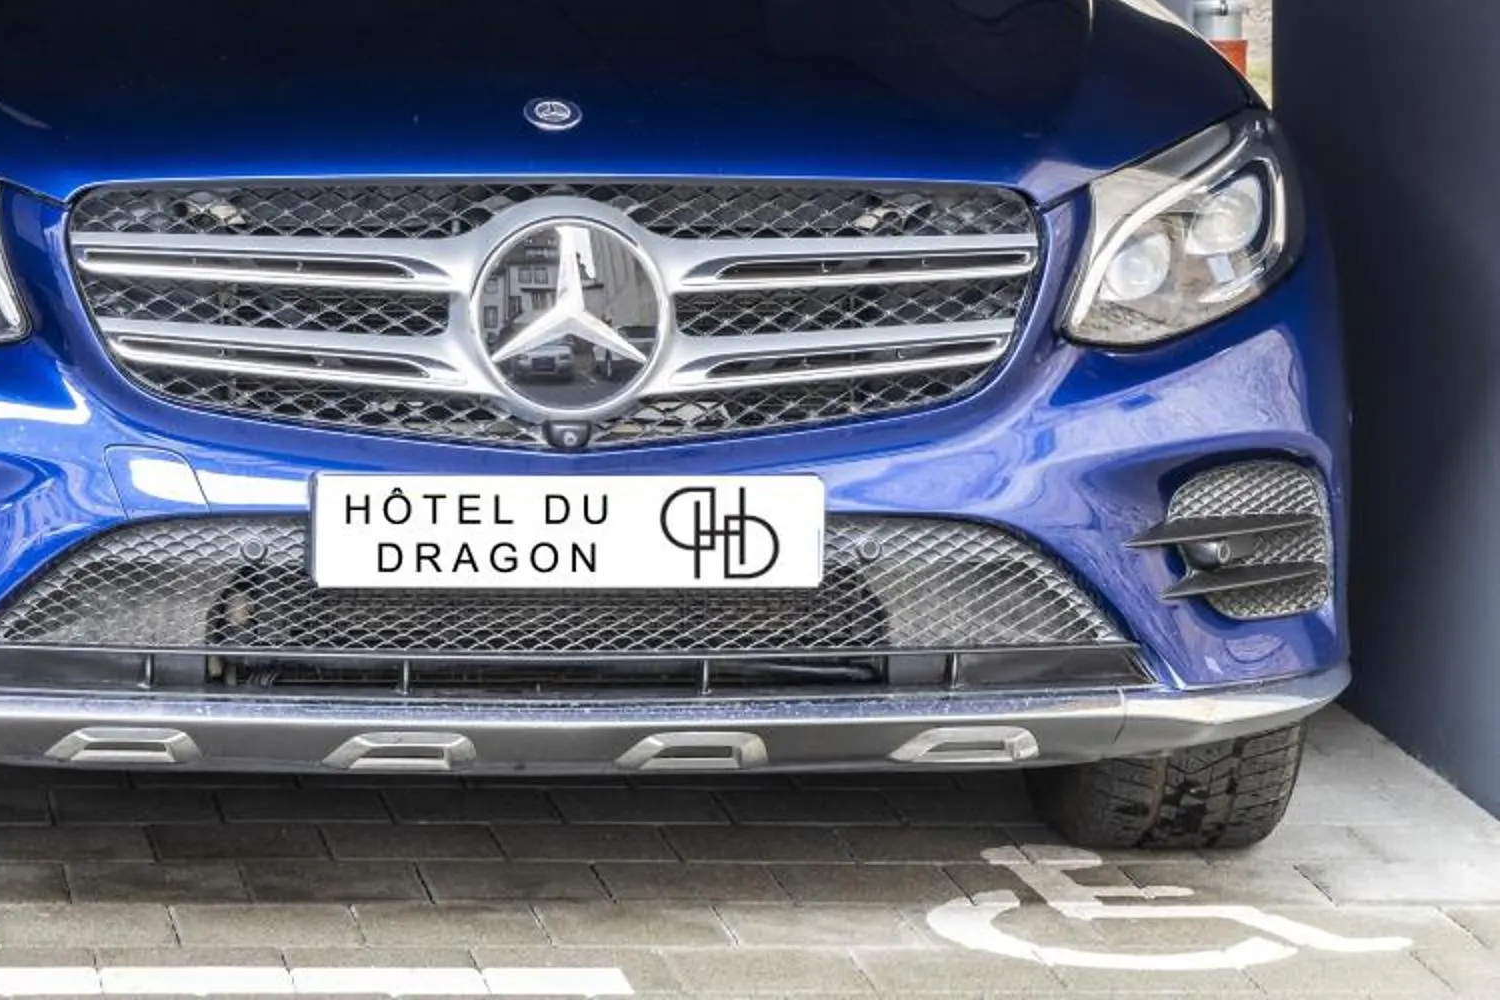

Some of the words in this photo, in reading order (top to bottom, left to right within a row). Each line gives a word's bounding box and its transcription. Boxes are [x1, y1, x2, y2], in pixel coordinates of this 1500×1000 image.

[345, 487, 514, 525] HÔTEL
[545, 494, 608, 525] DU
[378, 542, 596, 573] DRAGON
